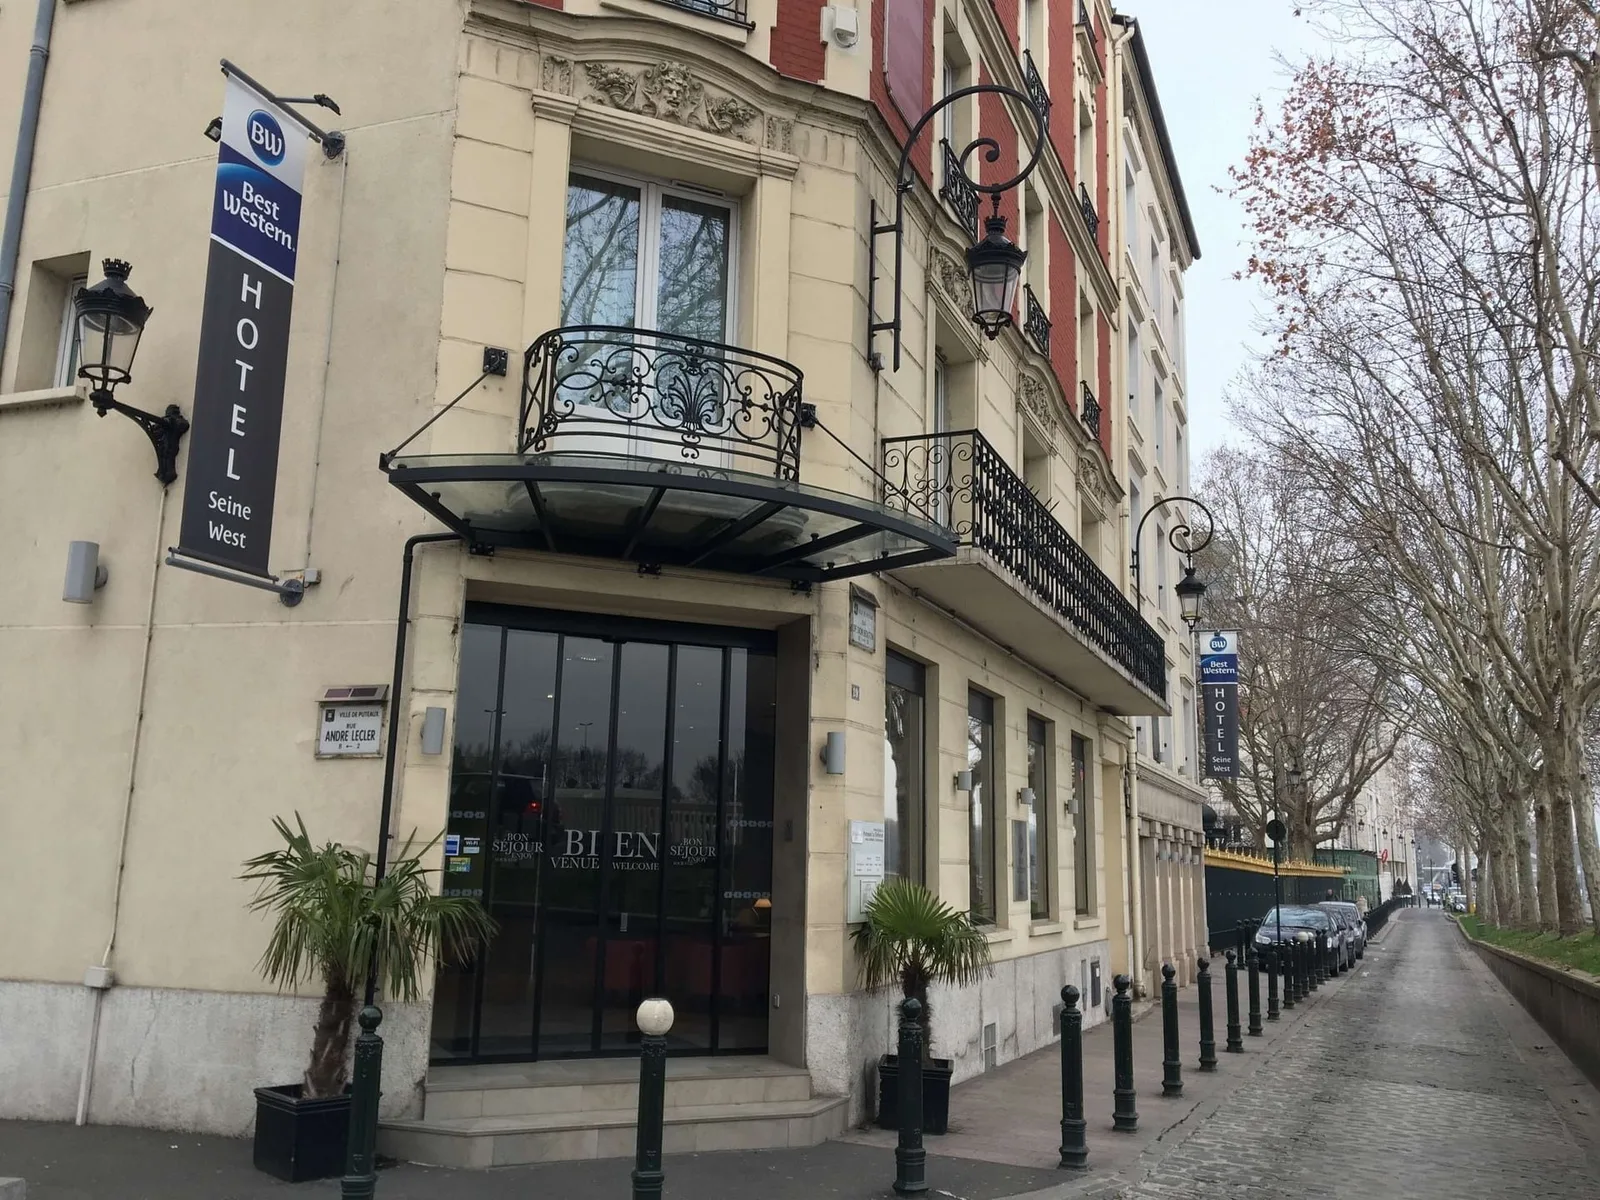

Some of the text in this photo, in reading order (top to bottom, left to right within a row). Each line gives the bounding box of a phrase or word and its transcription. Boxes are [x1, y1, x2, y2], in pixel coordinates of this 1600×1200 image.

[252, 120, 282, 157] BW
[242, 181, 280, 221] Best
[223, 189, 294, 251] Western
[226, 273, 263, 480] HOTEL
[208, 490, 251, 521] Seine
[208, 520, 247, 549] West
[1210, 640, 1226, 649] BW
[1210, 660, 1228, 668] Best
[1214, 688, 1226, 752] HOTEL
[351, 729, 376, 741] LECLER
[507, 833, 529, 841] BON
[682, 838, 703, 846] BON
[492, 838, 544, 855] SÉJOUR
[511, 852, 534, 860] ENJOY
[551, 856, 600, 869] VENUE
[612, 861, 660, 871] WELCOME
